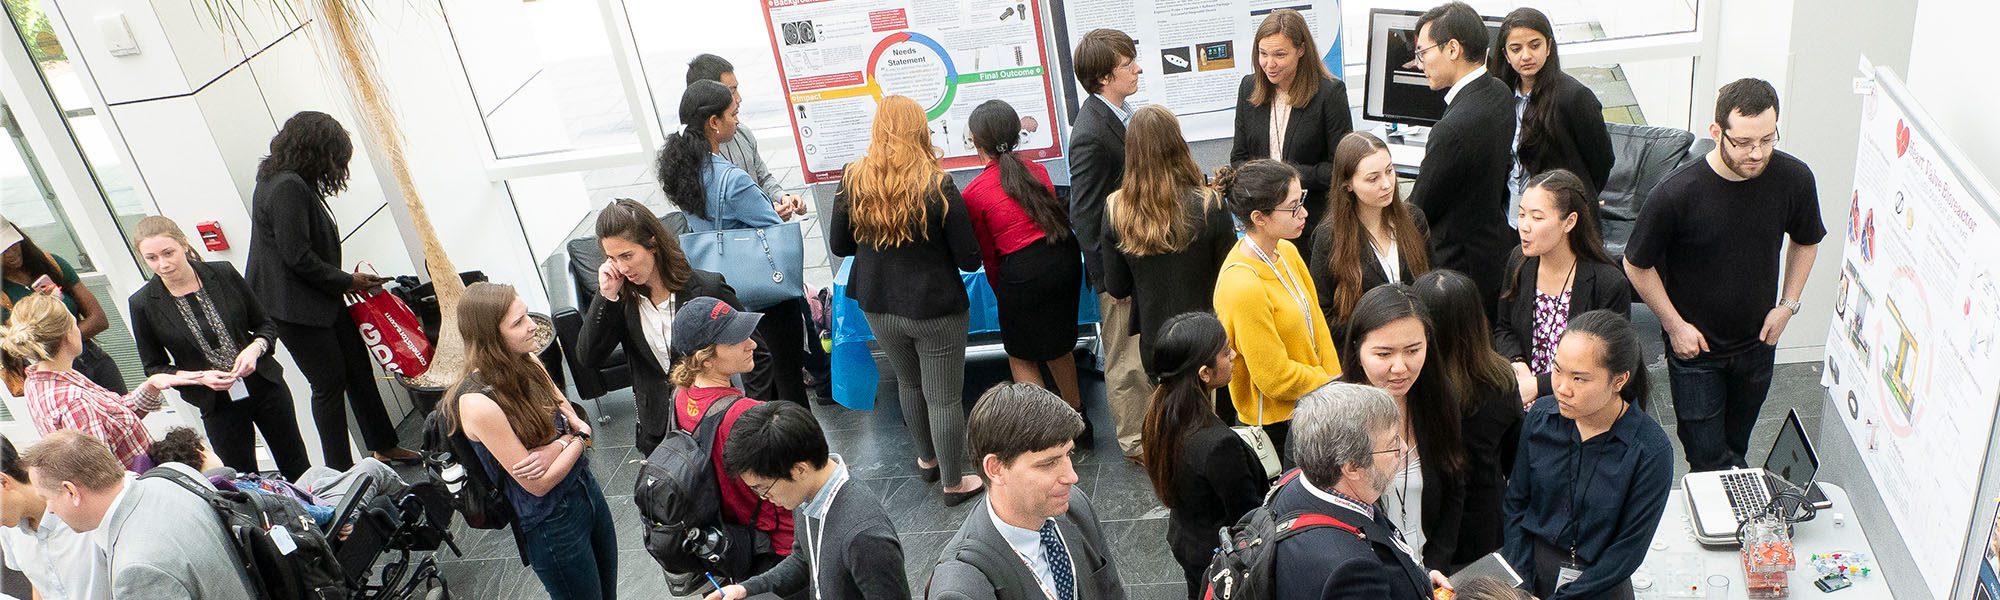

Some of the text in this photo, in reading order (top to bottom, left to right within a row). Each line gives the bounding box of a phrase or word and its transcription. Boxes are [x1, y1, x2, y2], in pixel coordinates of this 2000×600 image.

[893, 48, 917, 56] Needs
[888, 57, 926, 66] Statement
[980, 69, 1034, 80] Final Outcome
[796, 93, 822, 102] Impact
